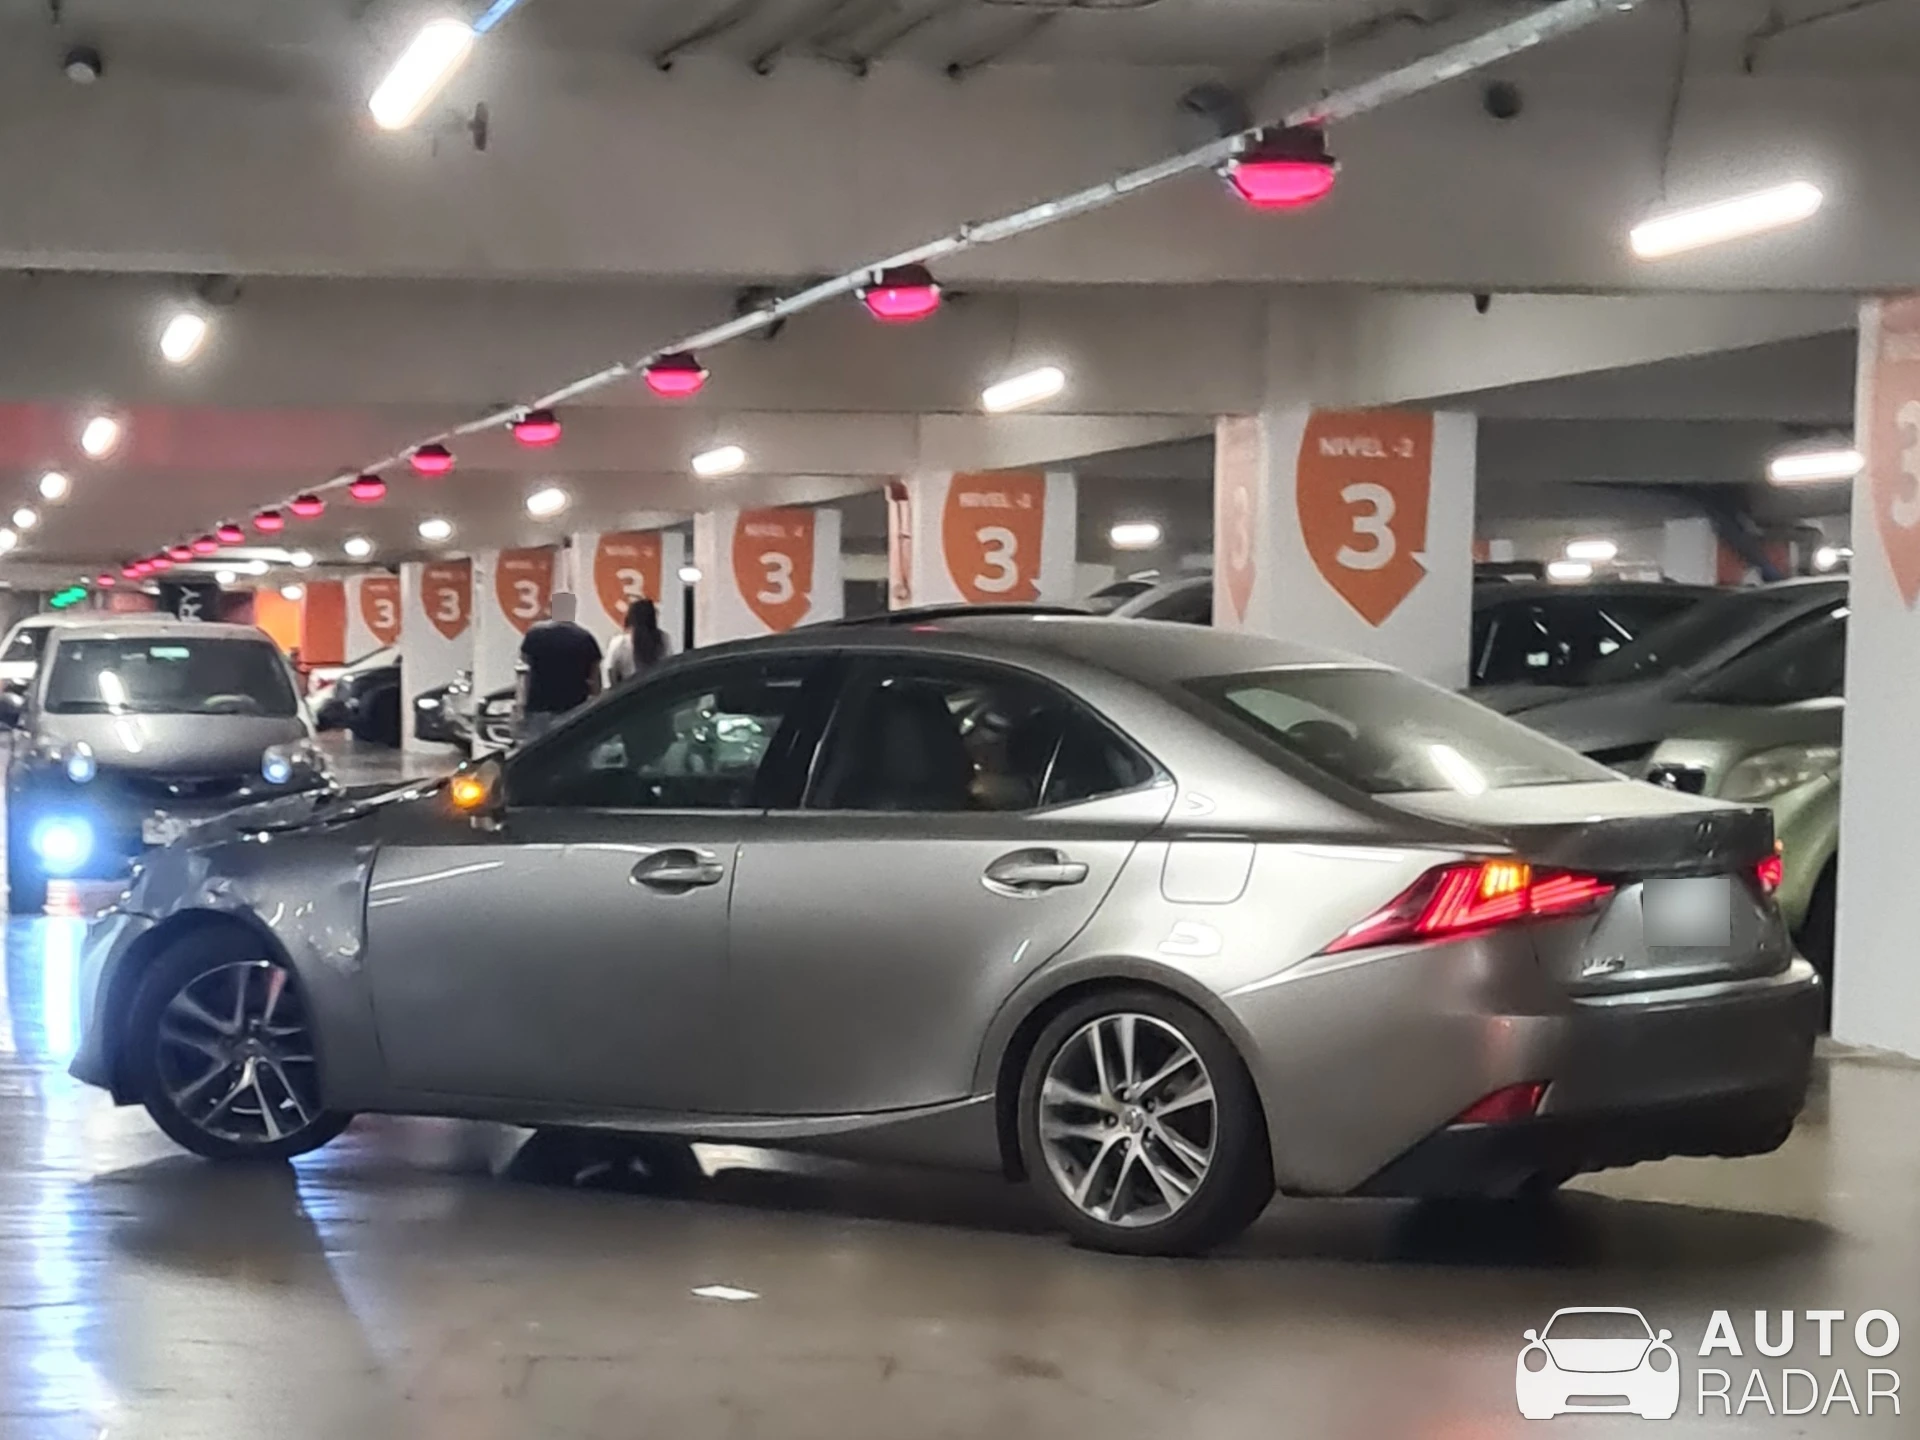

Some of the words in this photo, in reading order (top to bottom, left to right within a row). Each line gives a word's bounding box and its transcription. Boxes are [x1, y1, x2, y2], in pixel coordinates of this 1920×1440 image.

[1336, 482, 1396, 570] 3
[757, 551, 795, 604] 3
[974, 525, 1019, 593] 3
[374, 598, 395, 629] 3
[437, 588, 460, 622] 3
[512, 579, 541, 618] 3
